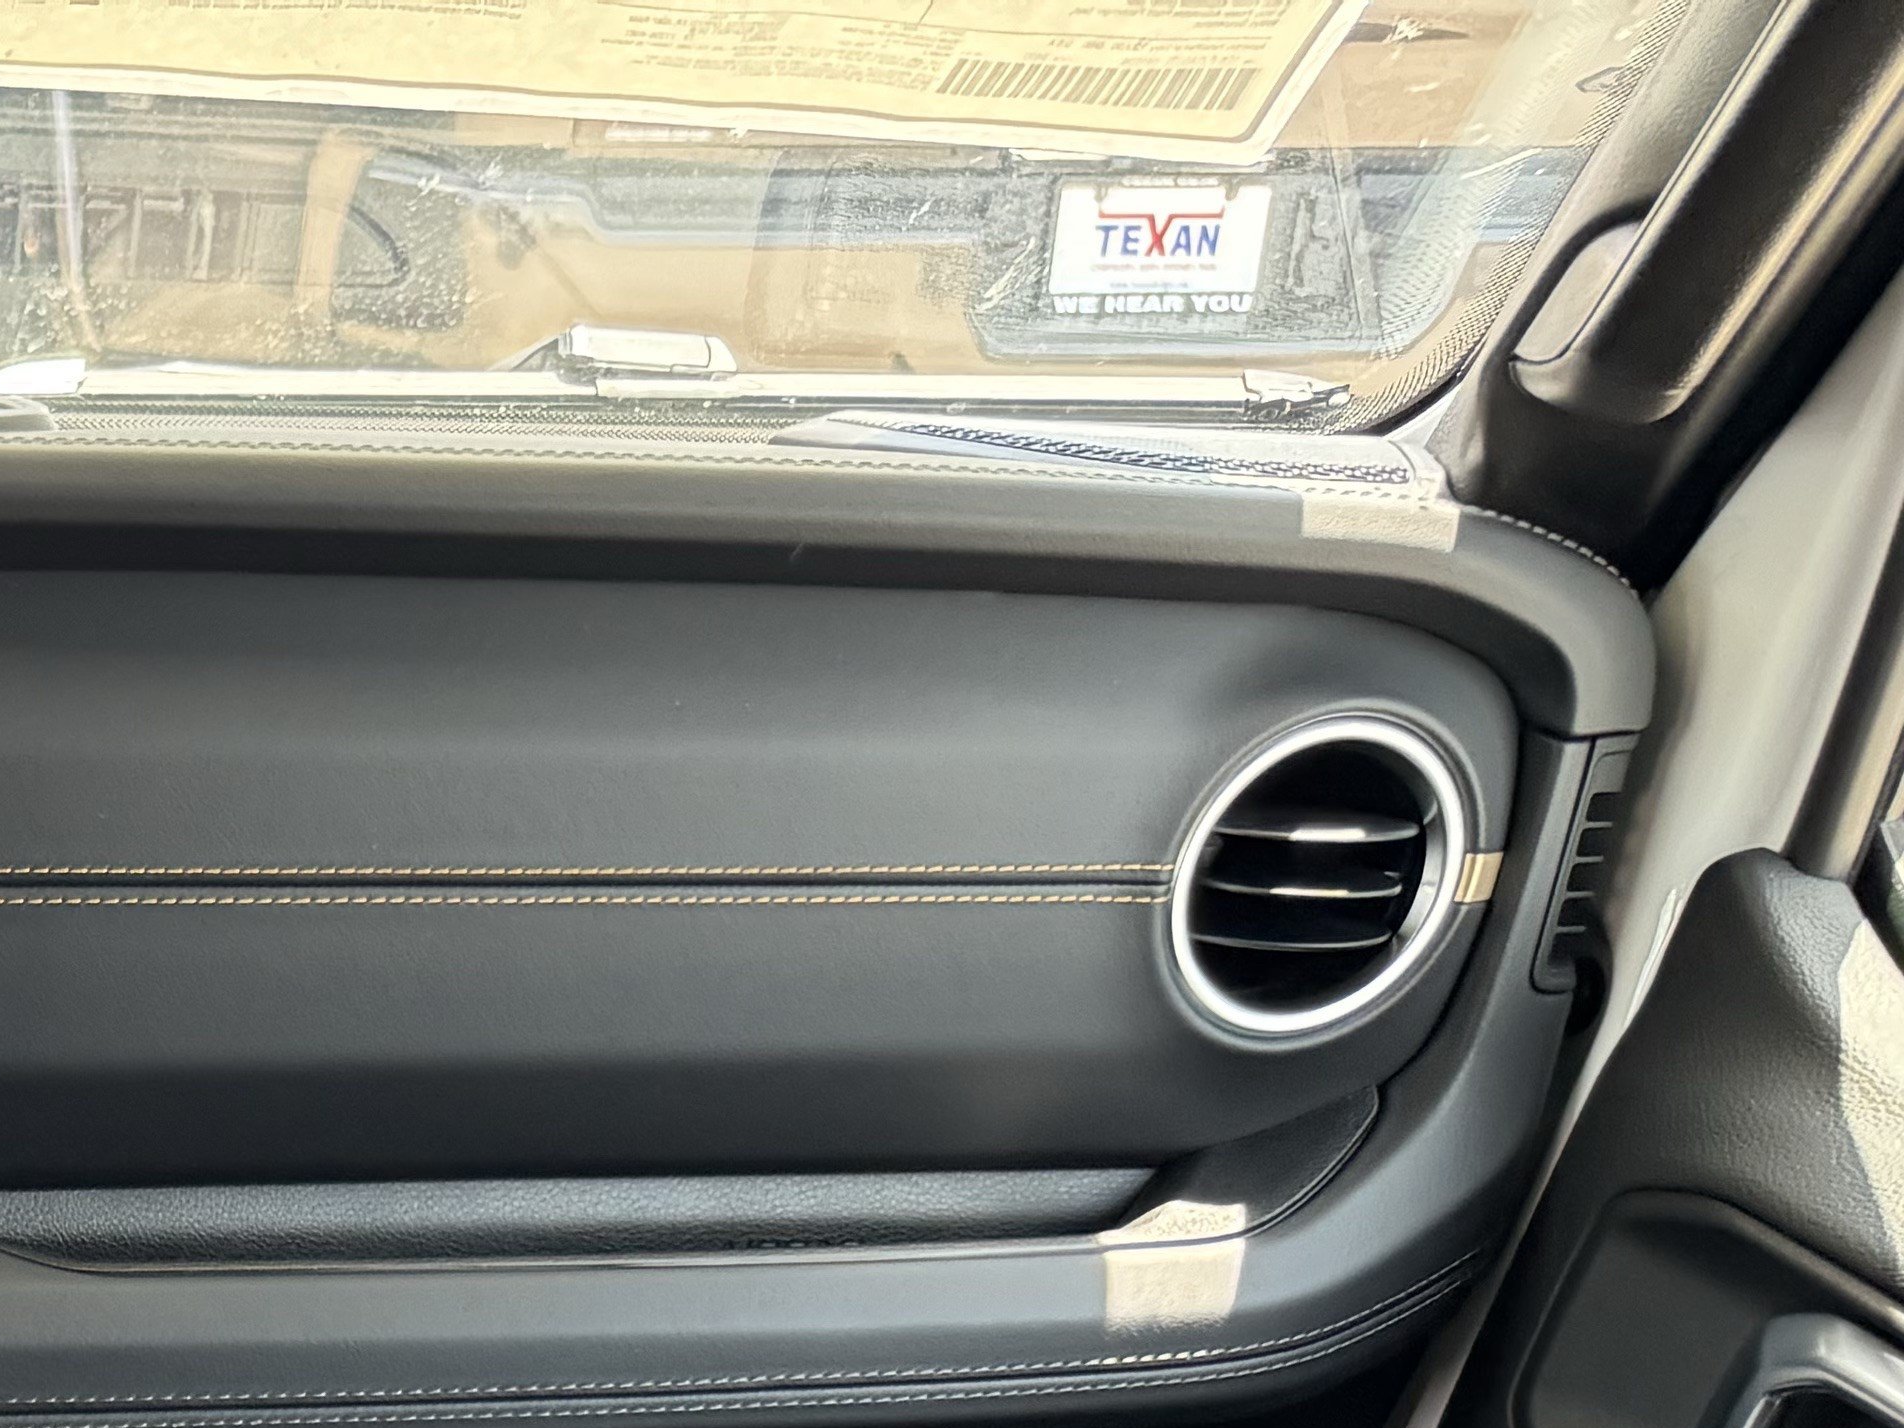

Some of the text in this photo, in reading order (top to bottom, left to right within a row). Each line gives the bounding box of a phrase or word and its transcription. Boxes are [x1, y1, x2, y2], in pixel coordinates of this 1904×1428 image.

[1096, 214, 1220, 257] TEXAN
[1053, 294, 1254, 313] WE HEAR YOU
